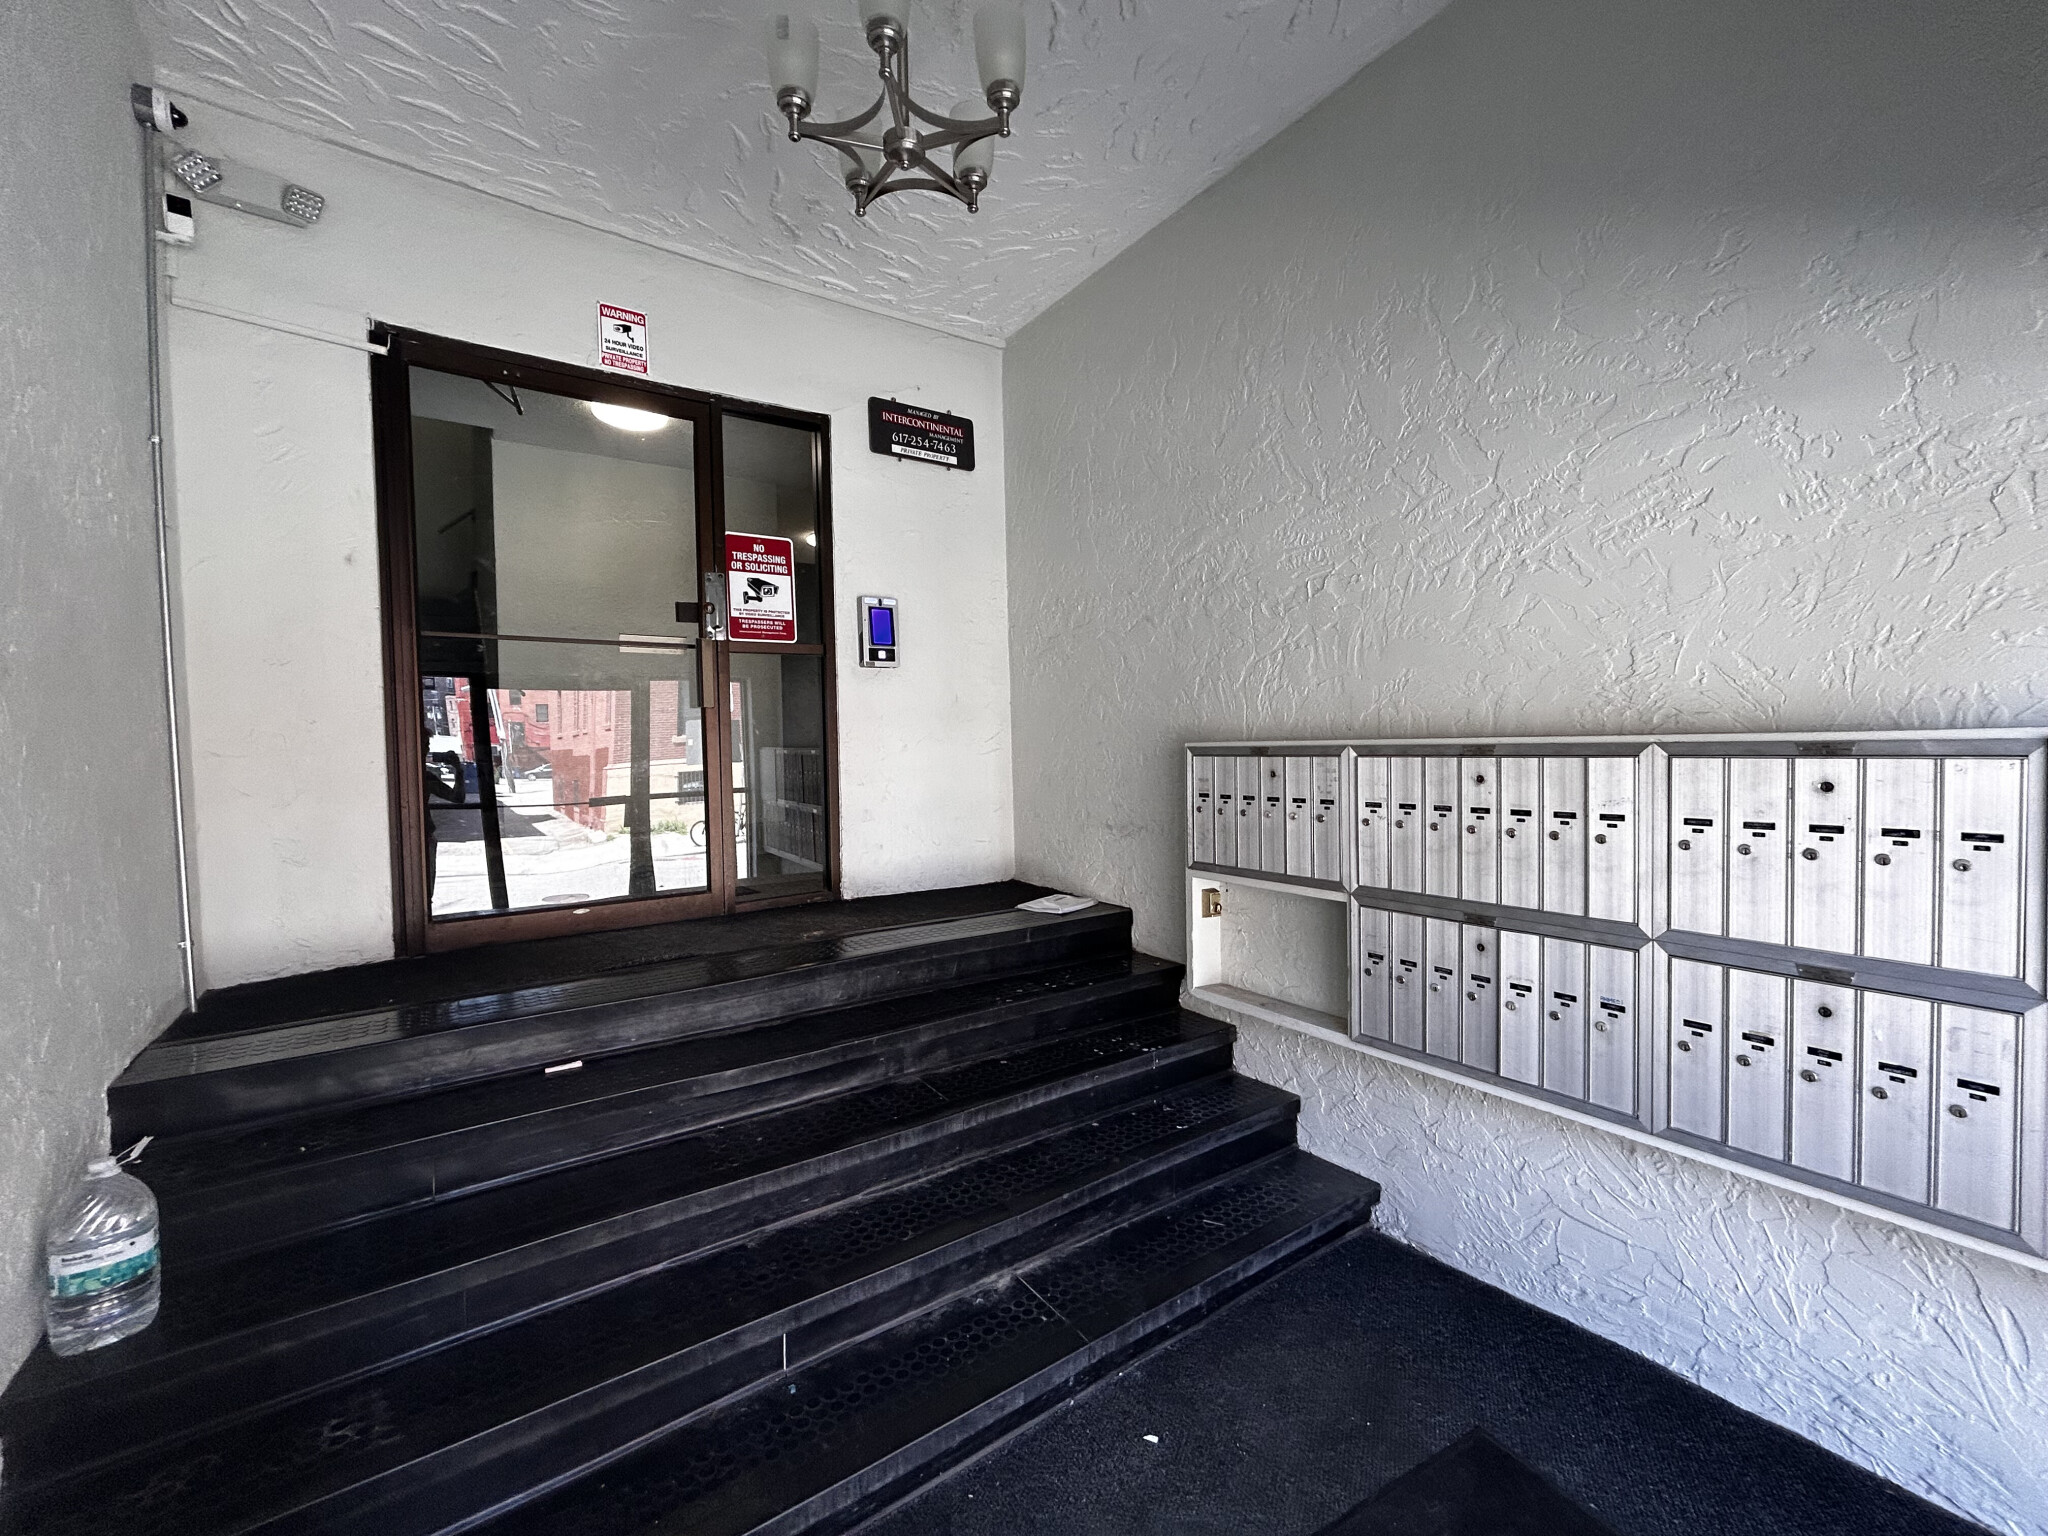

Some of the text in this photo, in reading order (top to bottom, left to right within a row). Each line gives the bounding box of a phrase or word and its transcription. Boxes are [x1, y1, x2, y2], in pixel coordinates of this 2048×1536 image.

[601, 306, 645, 325] WARNING
[605, 346, 643, 358] SURVEILLANCE
[628, 343, 644, 352] VIDEO
[613, 360, 645, 373] TRESPASSING
[623, 356, 647, 367] PROPERTY
[907, 408, 932, 418] MANAGED
[882, 411, 964, 437] INTERCONTINENTAL
[892, 432, 956, 453] 617-254-7463
[929, 432, 964, 444] MANAGEMENT
[900, 447, 950, 462] PRIVATE PROPERTY
[753, 544, 765, 553] NO
[732, 551, 786, 564] TRESPASSING
[731, 561, 788, 574] OR SOLICITING
